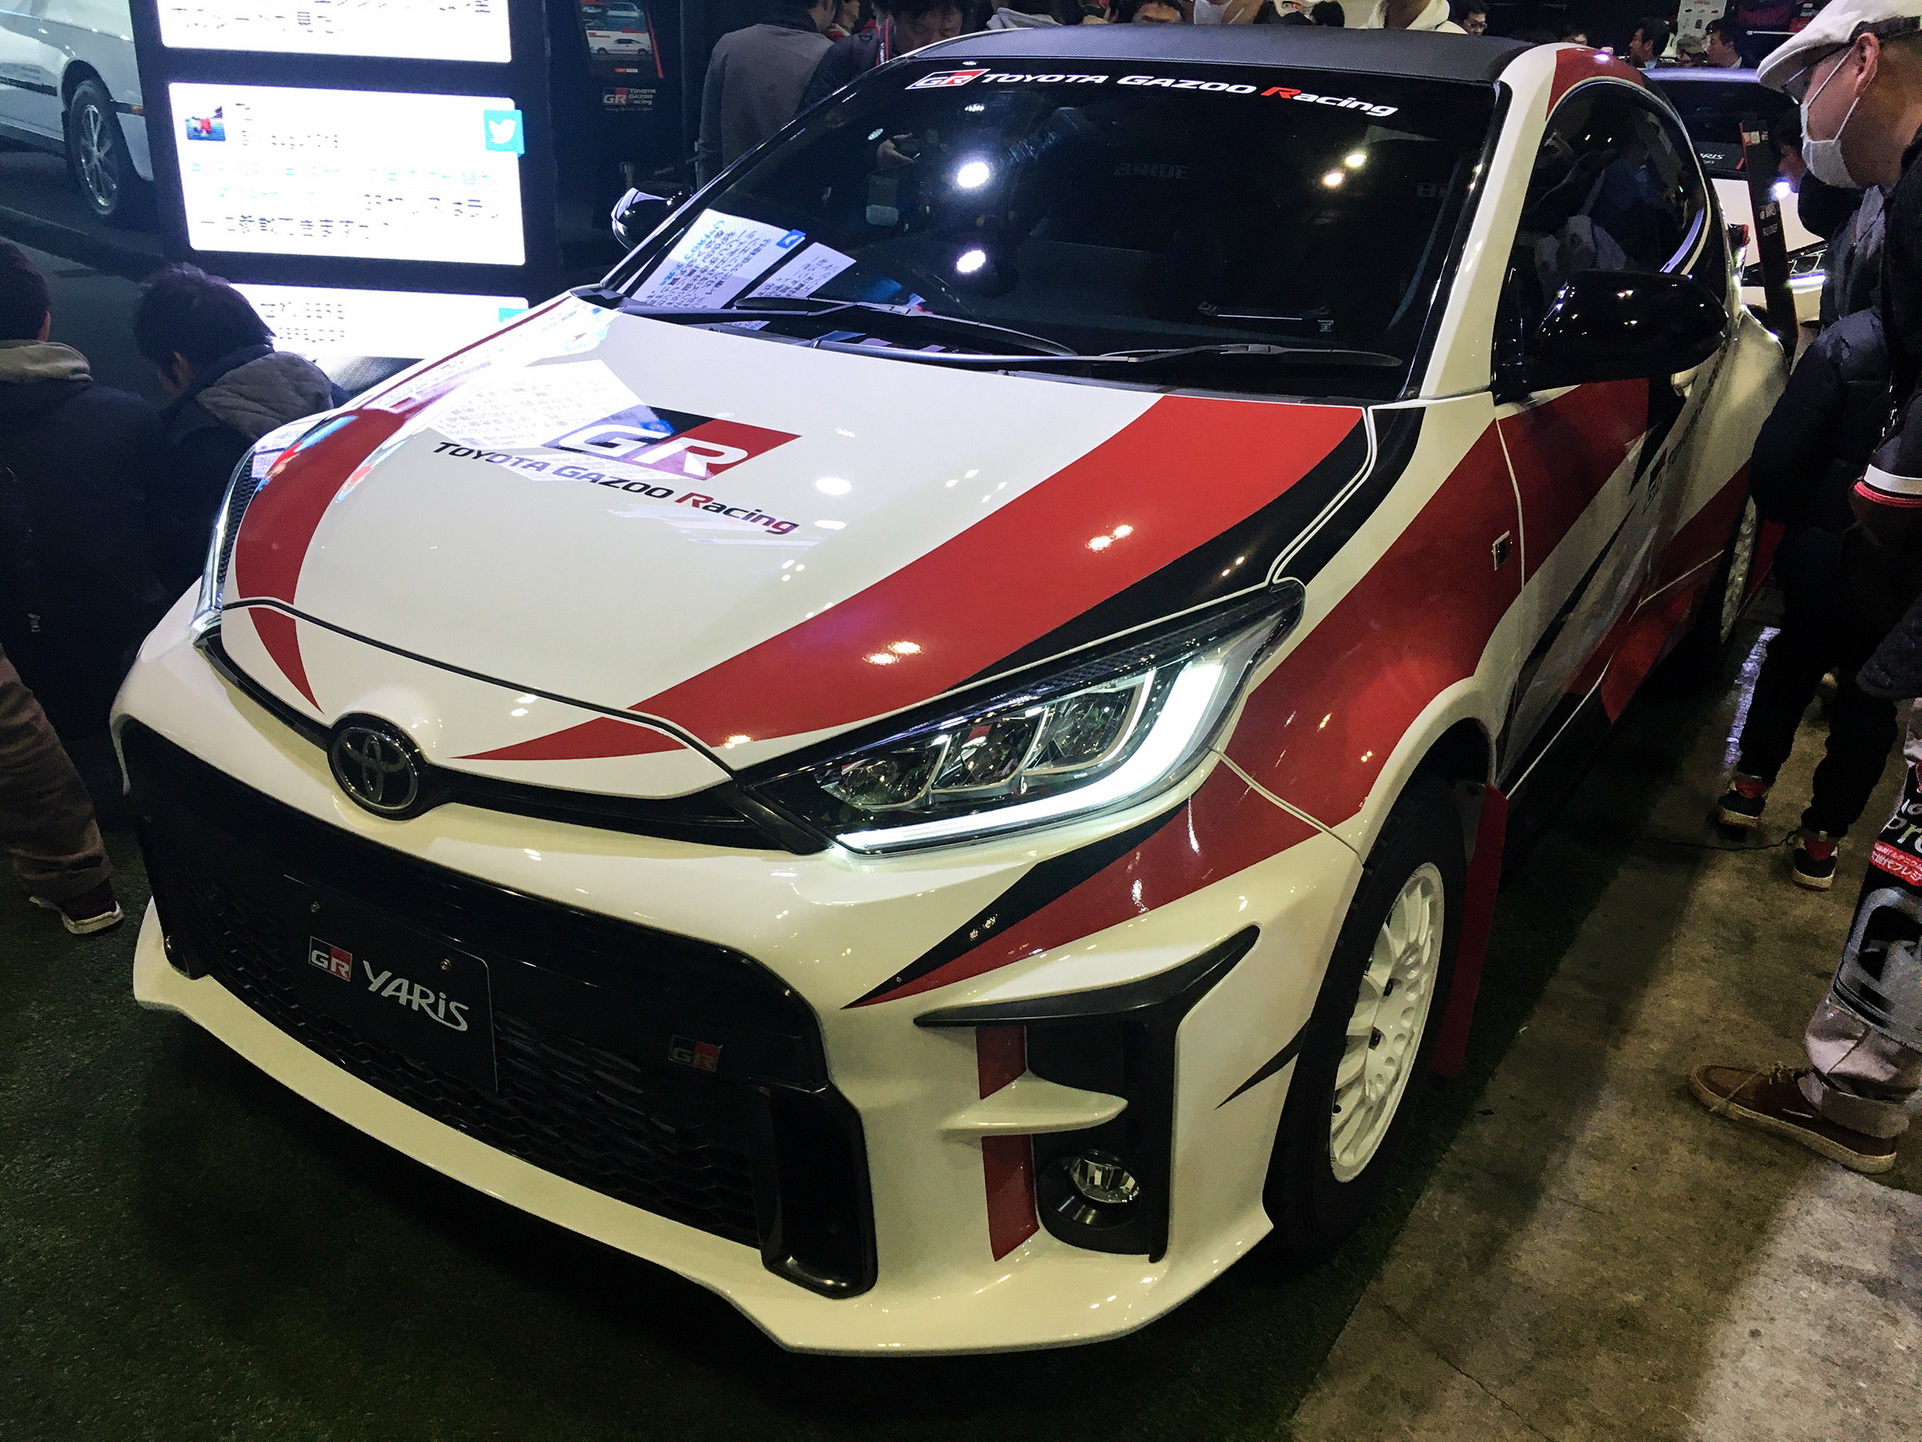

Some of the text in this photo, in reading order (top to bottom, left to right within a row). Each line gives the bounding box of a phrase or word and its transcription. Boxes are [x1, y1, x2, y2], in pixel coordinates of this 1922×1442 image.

[603, 93, 628, 105] GR
[912, 73, 1399, 117] GR TOYOTA GAZOO Racing
[555, 422, 754, 479] GR
[432, 441, 551, 472] TOYOTA
[552, 465, 675, 499] GAZOO
[674, 492, 800, 535] Racing
[310, 946, 351, 980] GR
[671, 1045, 716, 1070] GR
